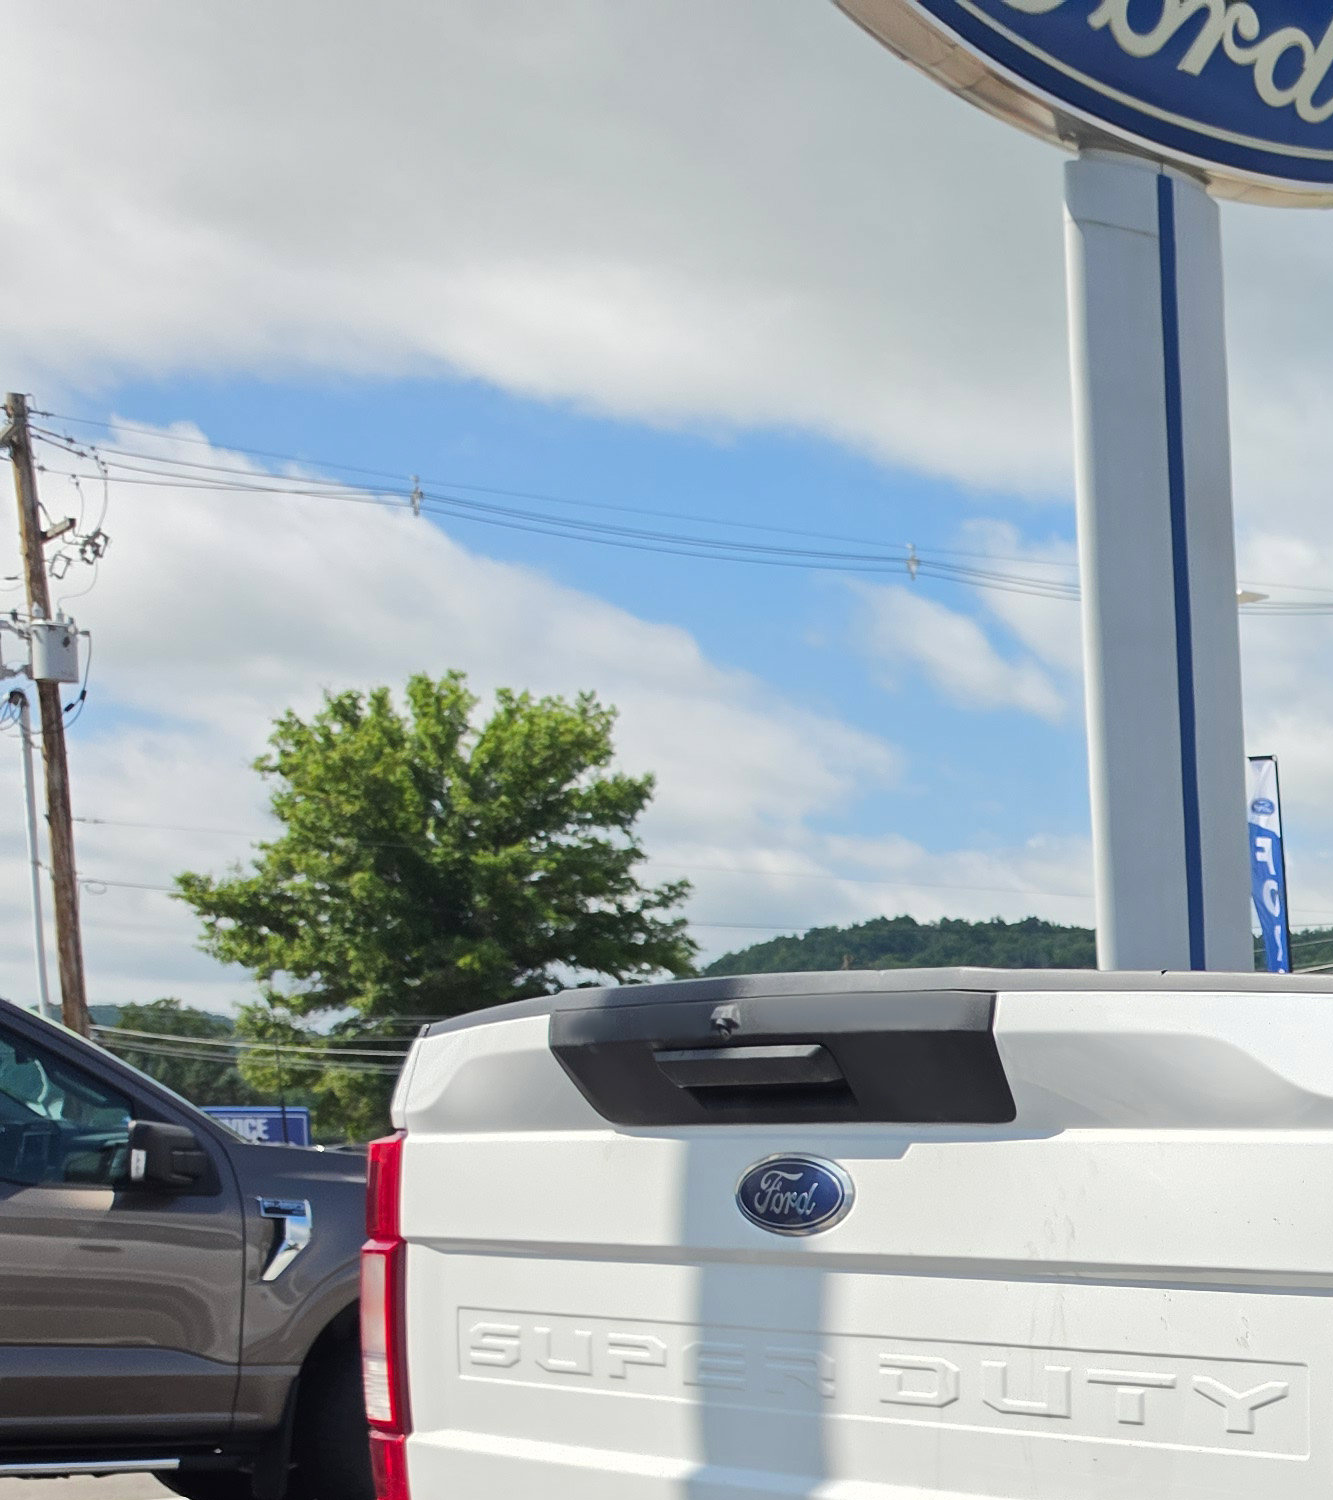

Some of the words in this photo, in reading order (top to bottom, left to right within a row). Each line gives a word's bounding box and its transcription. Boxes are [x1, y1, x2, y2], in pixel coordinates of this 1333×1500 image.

[754, 1169, 818, 1216] Ford
[469, 1321, 836, 1399] SUPER
[879, 1352, 1289, 1435] DUTY
